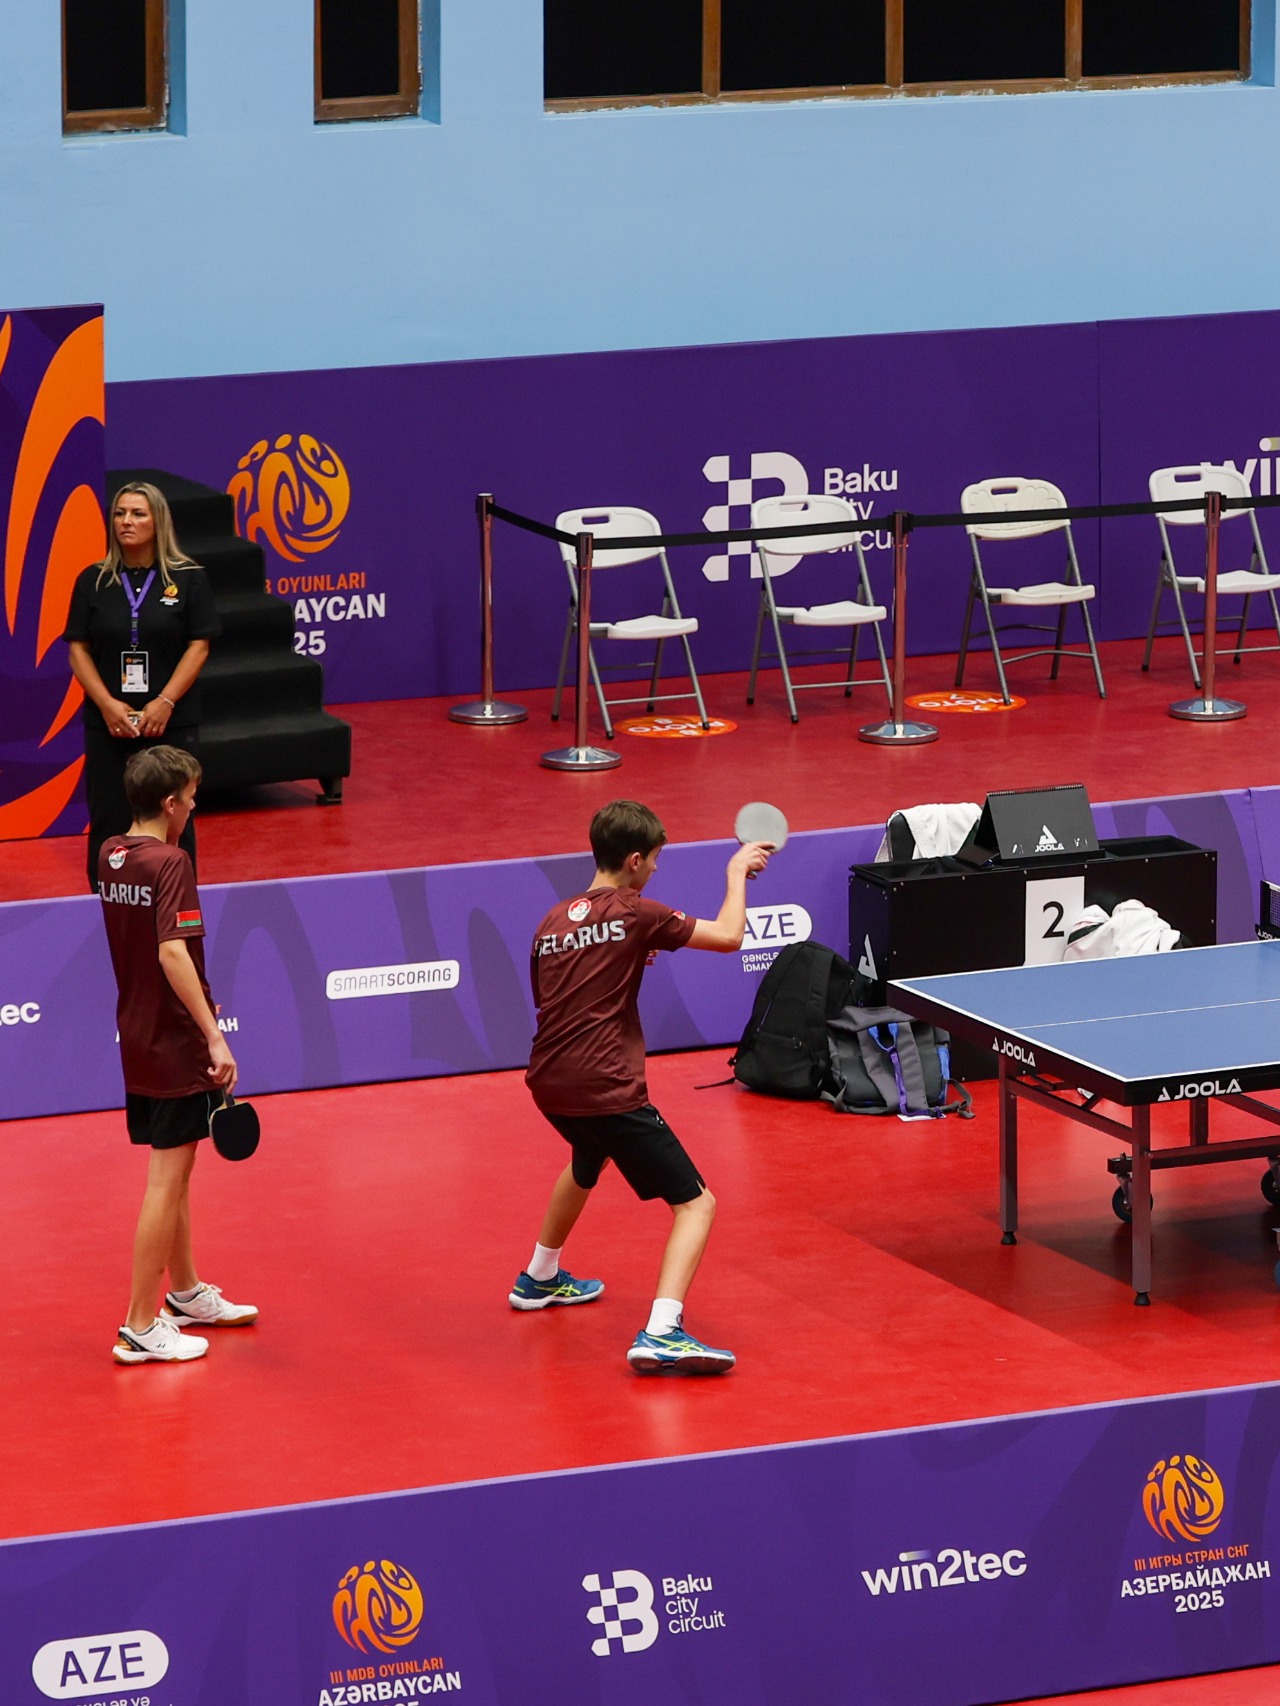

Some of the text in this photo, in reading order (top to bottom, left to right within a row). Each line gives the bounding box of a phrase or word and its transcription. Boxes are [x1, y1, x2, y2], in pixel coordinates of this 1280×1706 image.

[824, 464, 898, 495] Baku
[277, 572, 366, 594] OYUNLARI
[294, 593, 386, 623] AYCAN
[294, 630, 327, 655] 25
[1034, 842, 1065, 853] JOOLA
[98, 881, 151, 906] LARUS
[1042, 901, 1065, 939] 2
[334, 968, 451, 992] SMARTSCORING
[1000, 1040, 1036, 1067] JOOLA
[1174, 1079, 1242, 1100] JOOLA
[1149, 1553, 1182, 1569] ИГРЫ
[1185, 1548, 1225, 1565] СТРАН
[1227, 1544, 1250, 1560] СНГ
[861, 1548, 1028, 1596] win2tec
[1120, 1560, 1271, 1598] АЗЕРБАЙДЖАН
[662, 1574, 713, 1597] Baku
[665, 1596, 699, 1618] city
[1174, 1590, 1225, 1613] 2025
[668, 1610, 726, 1635] circuit
[59, 1642, 145, 1688] AZE
[347, 1666, 375, 1682] MDB
[379, 1657, 444, 1678] OYUNLARI
[318, 1671, 462, 1706] AZƏRBAYCAN
